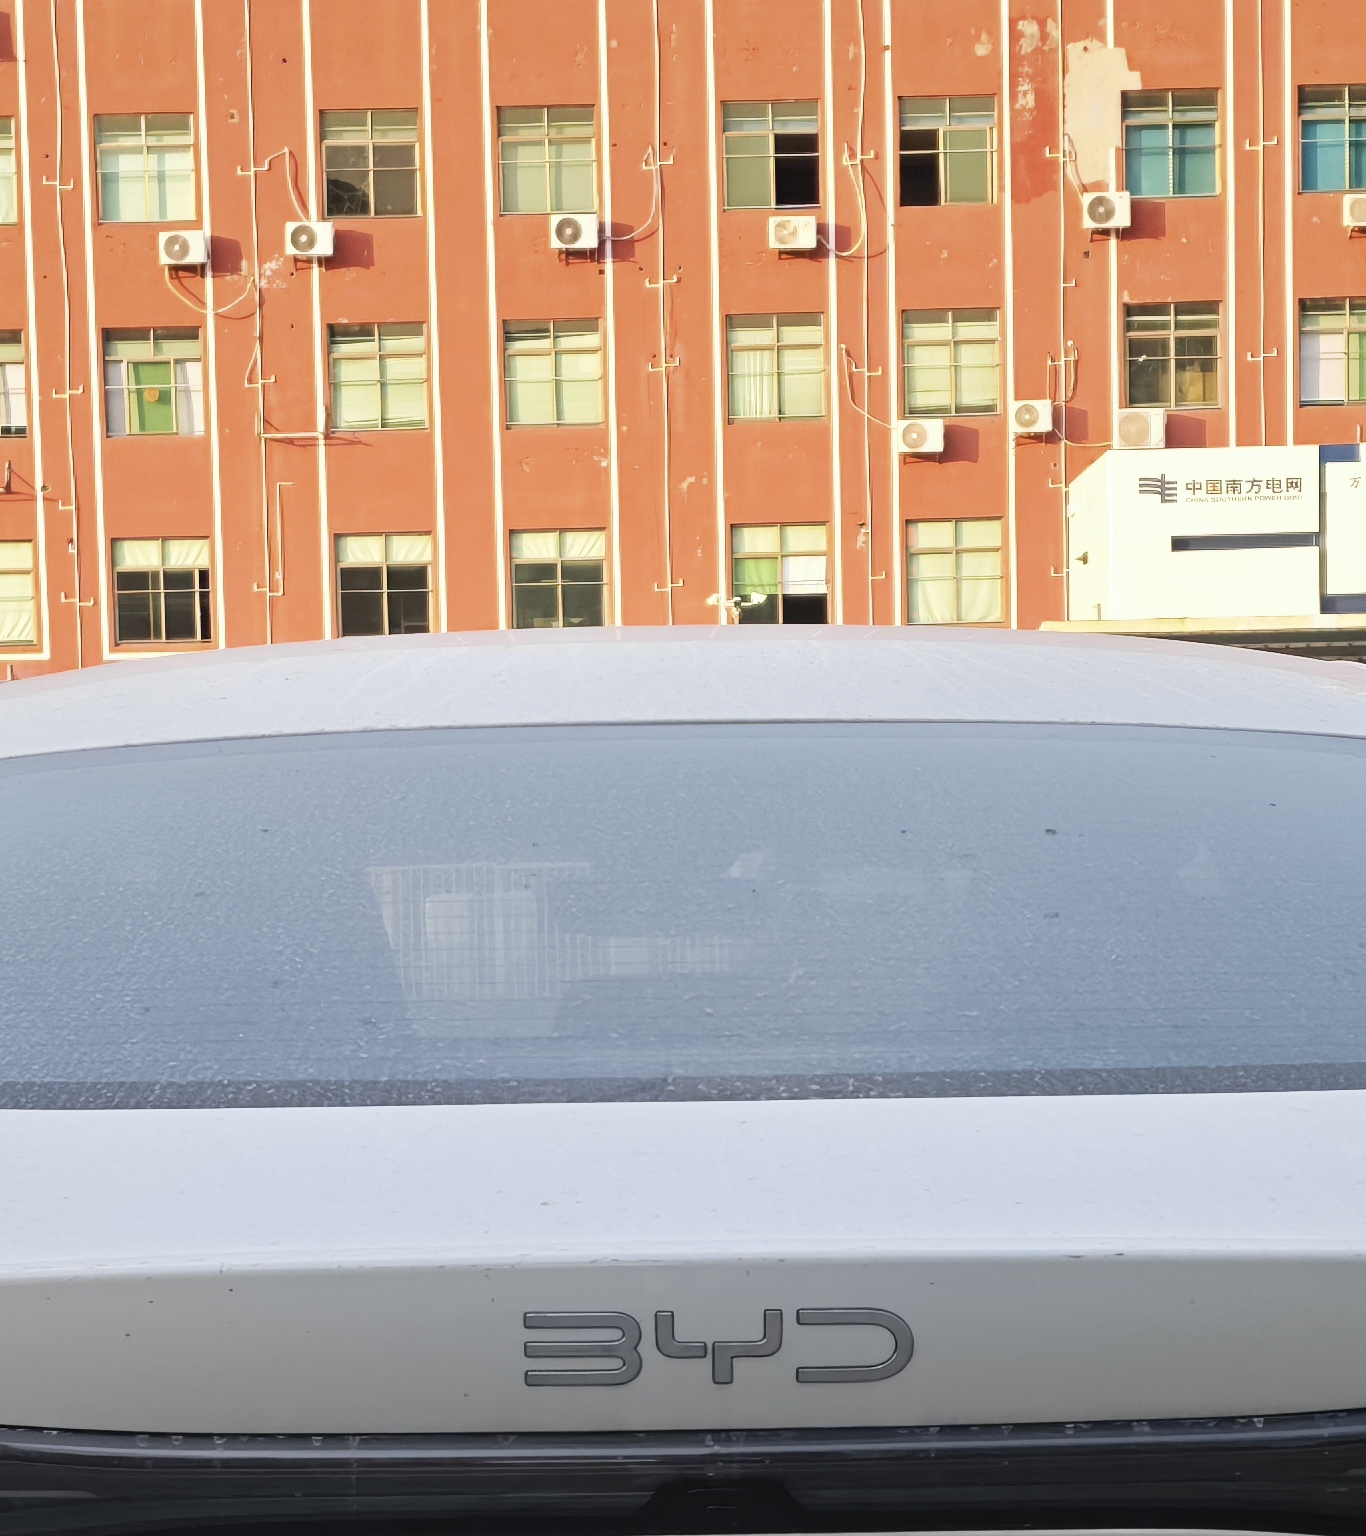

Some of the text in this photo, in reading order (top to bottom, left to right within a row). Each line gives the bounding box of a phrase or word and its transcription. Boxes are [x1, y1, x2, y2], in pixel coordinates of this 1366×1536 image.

[1185, 477, 1303, 496] 中国南方电网
[523, 1307, 915, 1387] BYD
